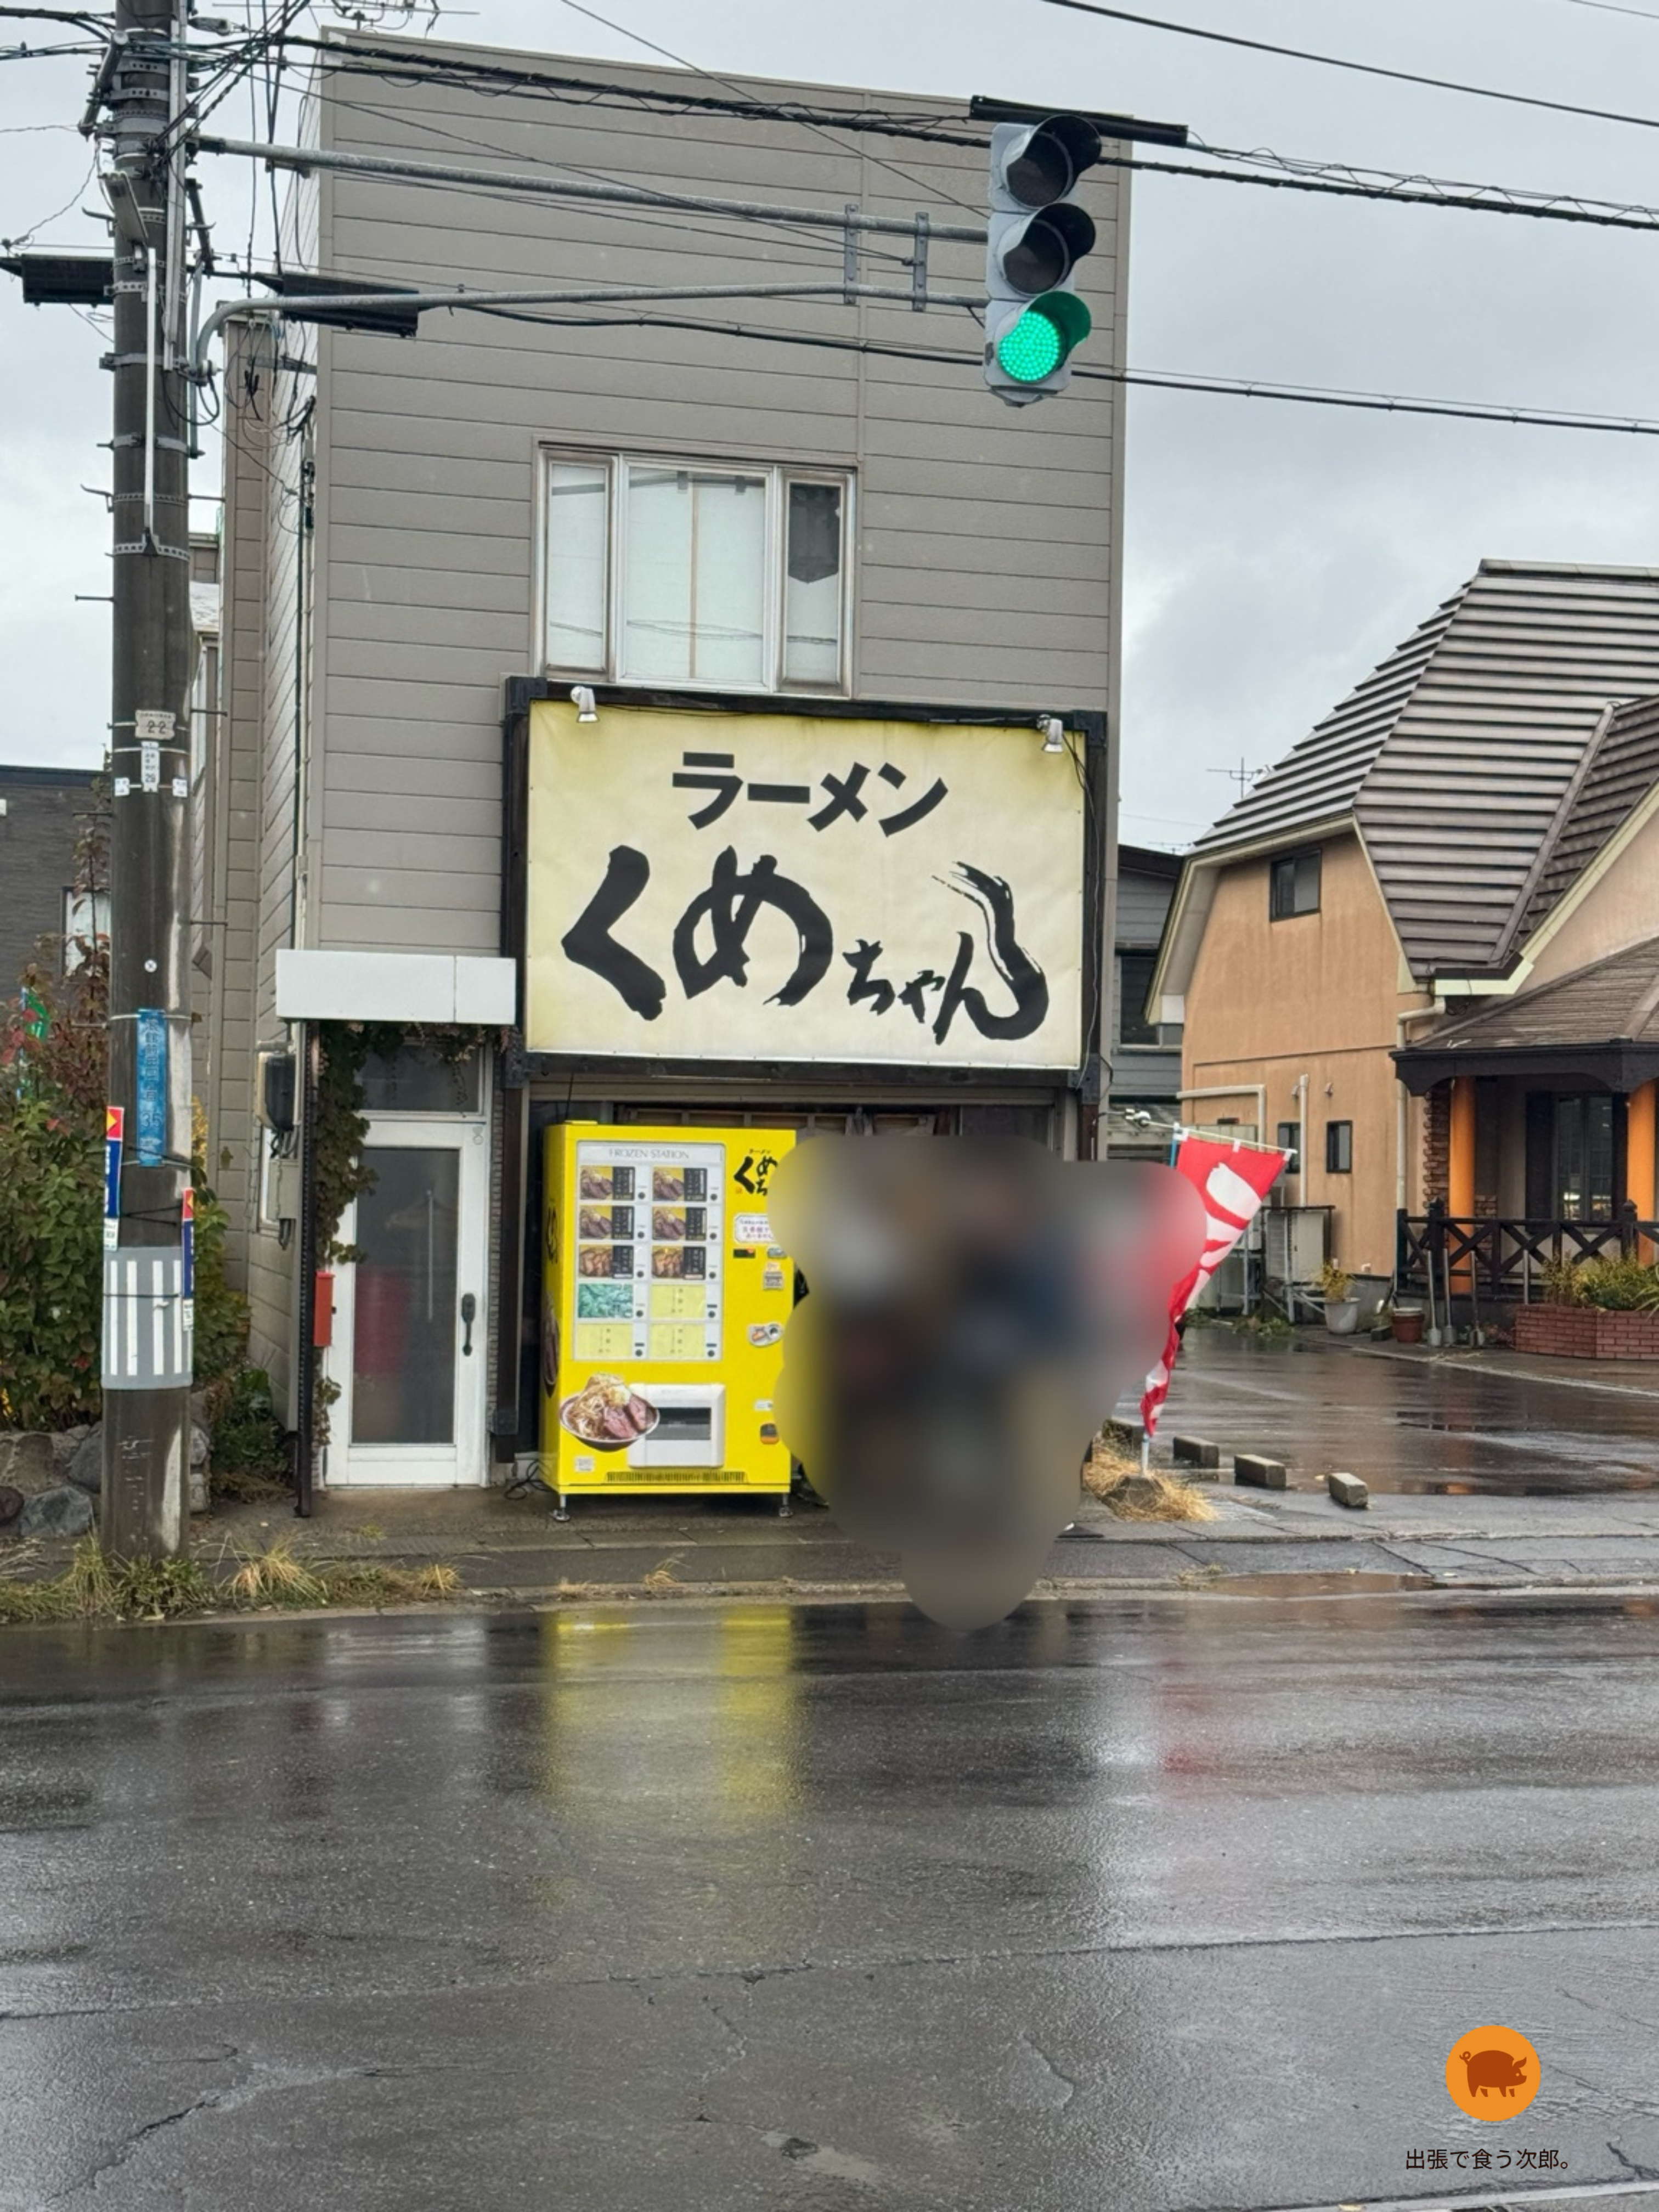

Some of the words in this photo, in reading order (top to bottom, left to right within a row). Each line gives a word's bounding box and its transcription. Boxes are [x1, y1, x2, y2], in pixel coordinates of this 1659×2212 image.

[148, 720, 166, 735] 22
[673, 752, 949, 837] ラーメン
[561, 845, 1048, 1046] くめちゃん
[140, 1113, 162, 1128] 35
[609, 1148, 648, 1158] FROZEN
[651, 1149, 689, 1159] STATION
[733, 1155, 778, 1196] くめち
